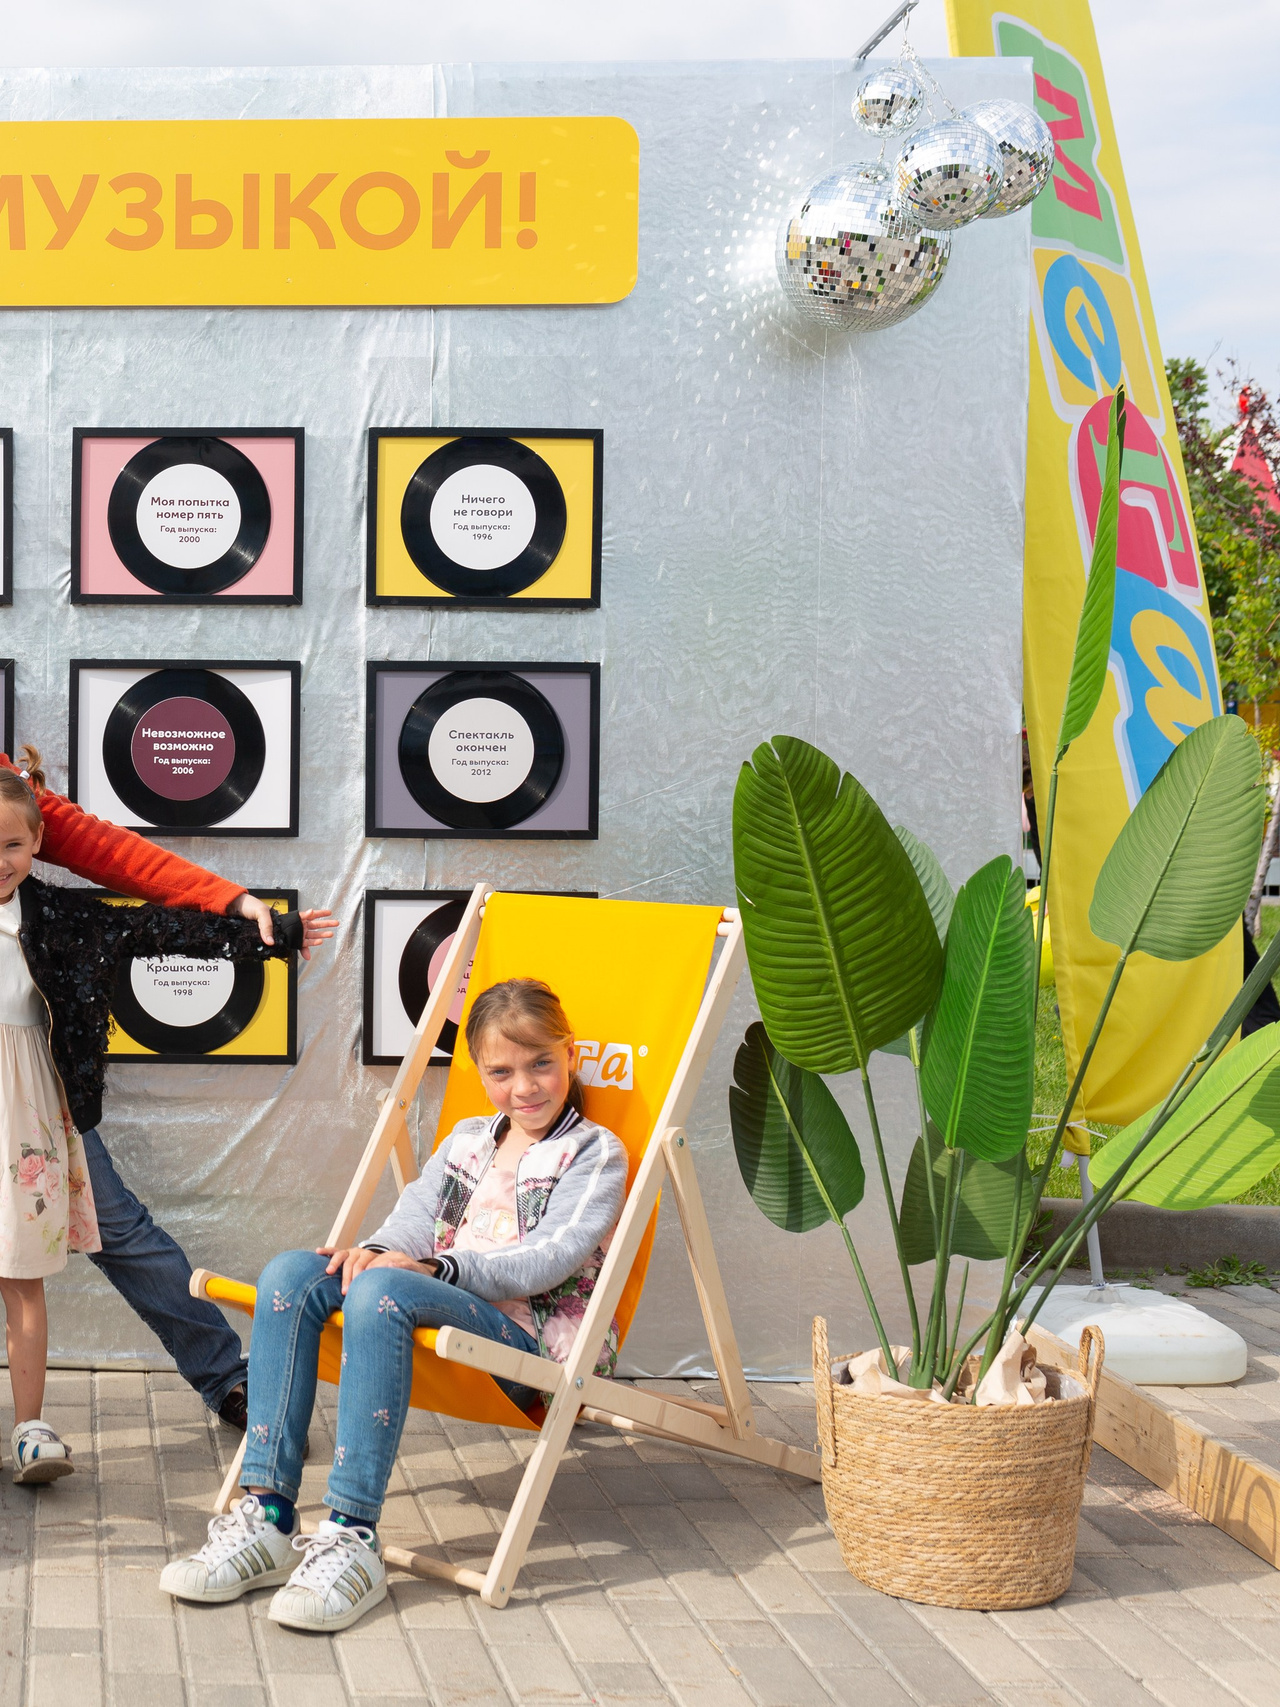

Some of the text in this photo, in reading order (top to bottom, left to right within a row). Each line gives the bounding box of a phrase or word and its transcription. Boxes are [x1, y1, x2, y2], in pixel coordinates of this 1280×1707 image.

[151, 497, 229, 508] Моя попытка
[461, 495, 505, 504] Ничего
[157, 512, 223, 521] номер пять
[471, 510, 513, 519] говори
[160, 526, 217, 535] Год выпуска:
[453, 523, 469, 531] Год
[179, 536, 200, 544] 2000
[142, 728, 226, 739] Невозможное
[449, 730, 514, 739] Спектакль
[153, 743, 214, 752] возможно
[456, 745, 506, 753] окончен
[154, 757, 211, 766] Год выпуска:
[452, 759, 509, 768] Год выпуска:
[172, 767, 194, 775] 2006
[147, 963, 219, 974] Крошка моя
[154, 979, 210, 988] Год выпуска:
[173, 989, 193, 997] 1998
